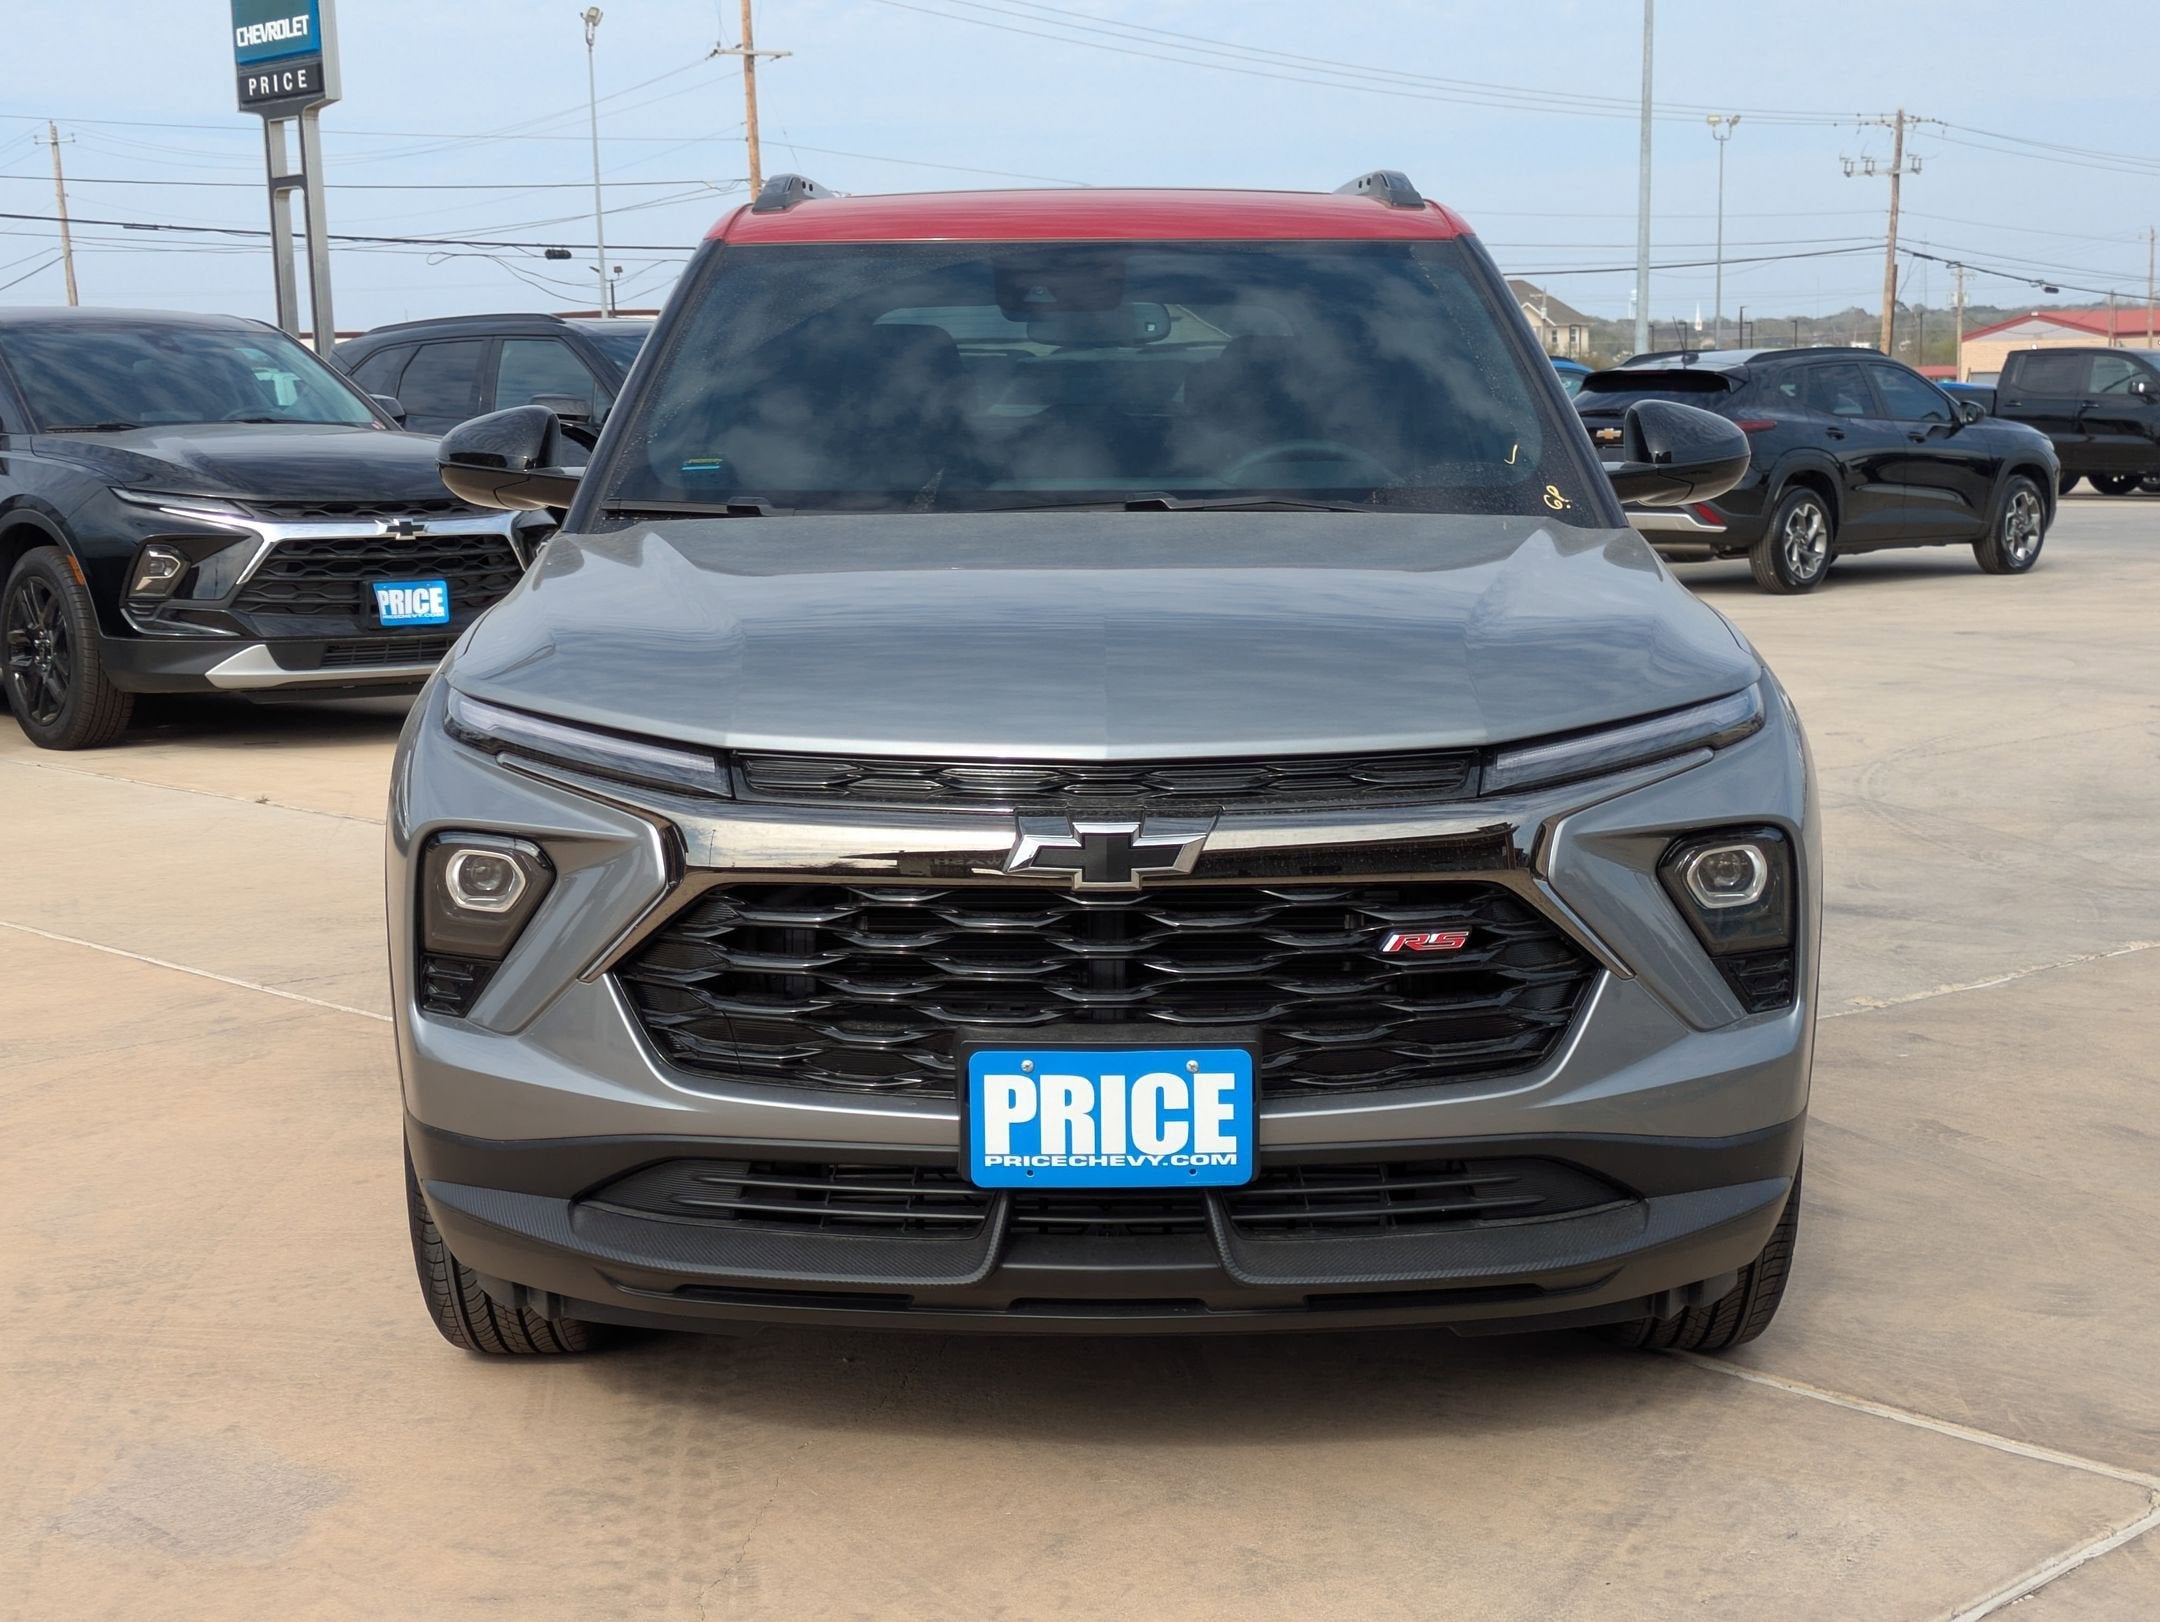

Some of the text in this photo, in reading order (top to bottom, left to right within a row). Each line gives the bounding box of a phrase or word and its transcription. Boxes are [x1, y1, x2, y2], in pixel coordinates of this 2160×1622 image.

[236, 15, 309, 47] CHEVROLET
[249, 69, 308, 96] PRICE
[377, 587, 445, 615] PRICE
[1382, 931, 1469, 952] RS
[983, 1072, 1237, 1155] PRICE
[984, 1154, 1237, 1167] PRICECHEVY.COM
